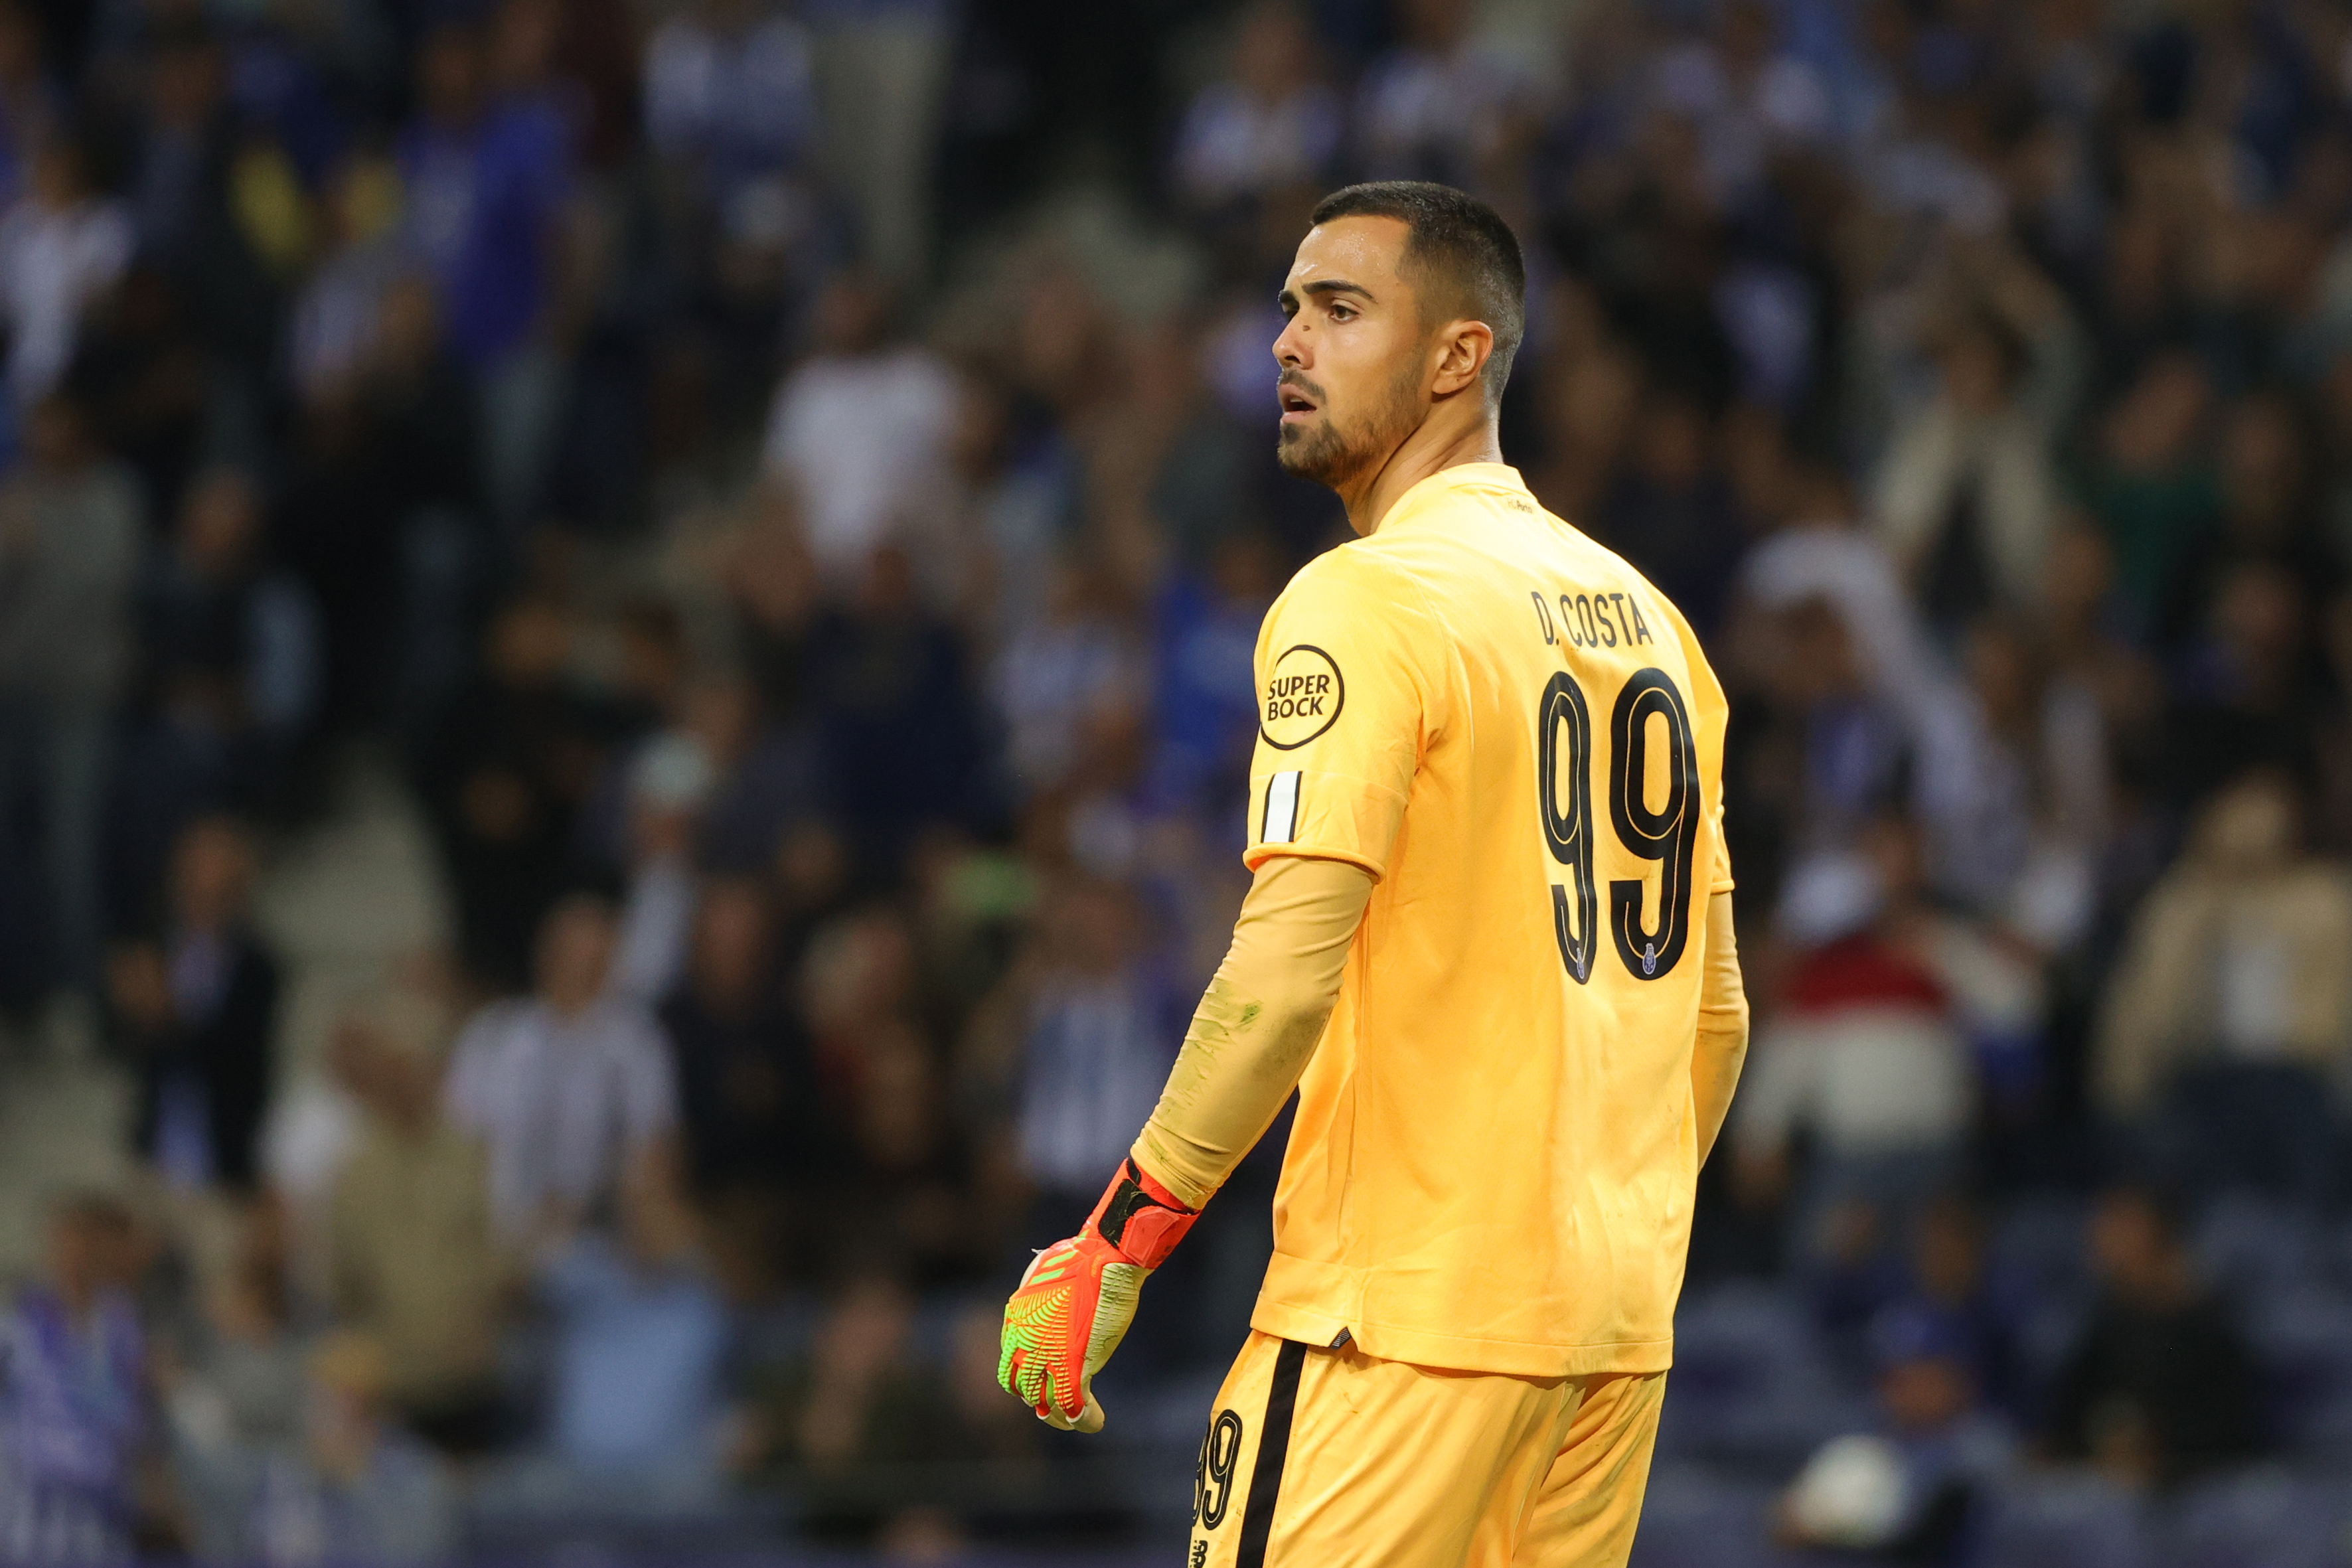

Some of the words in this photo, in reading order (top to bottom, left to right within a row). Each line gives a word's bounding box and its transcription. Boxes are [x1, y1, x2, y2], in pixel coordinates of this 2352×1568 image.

[1531, 591, 1559, 645] D.
[1559, 593, 1653, 648] COSTA
[1267, 674, 1330, 700] SUPER
[1267, 696, 1324, 721] BOCK
[1539, 667, 1699, 985] 99
